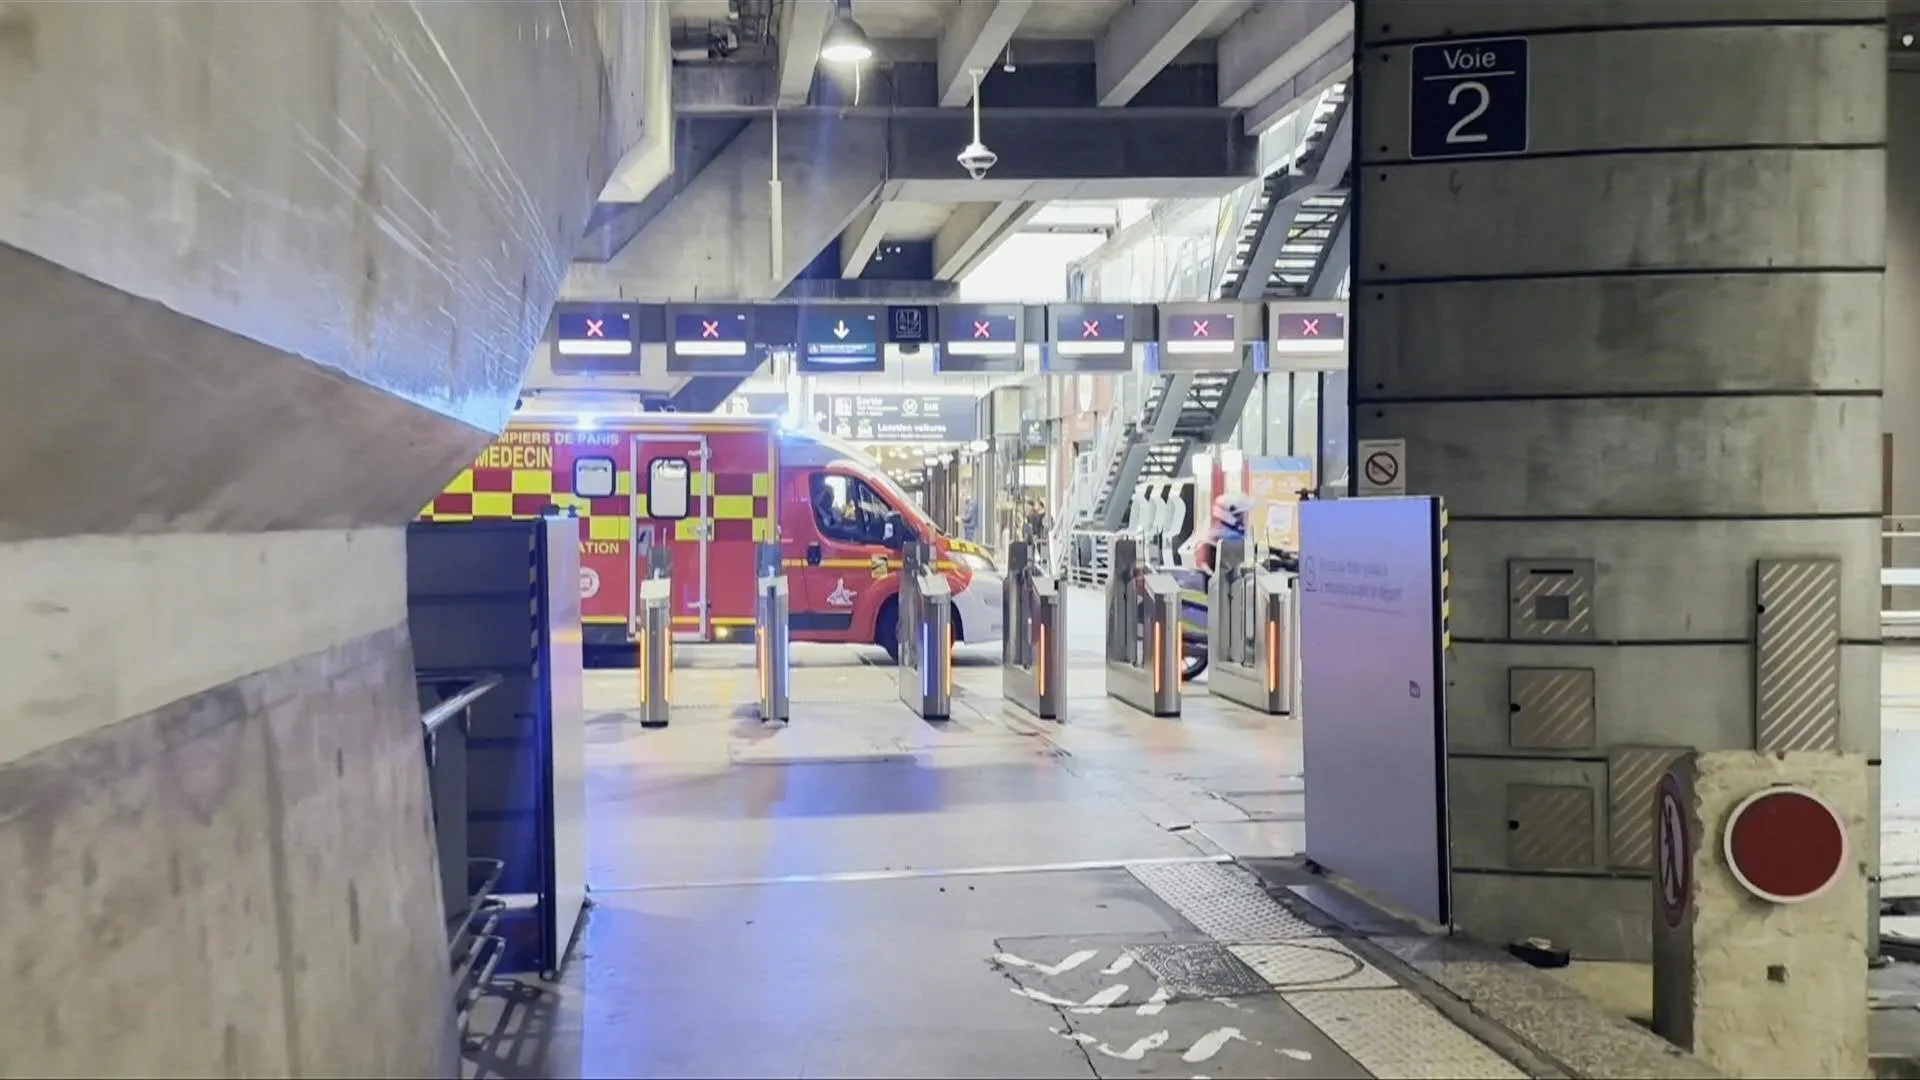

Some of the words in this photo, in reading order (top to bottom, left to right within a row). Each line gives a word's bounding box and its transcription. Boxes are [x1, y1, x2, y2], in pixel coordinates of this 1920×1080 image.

[1444, 48, 1496, 70] Voie
[1446, 81, 1490, 144] 2
[555, 432, 574, 444] DE
[578, 432, 619, 446] PARIS
